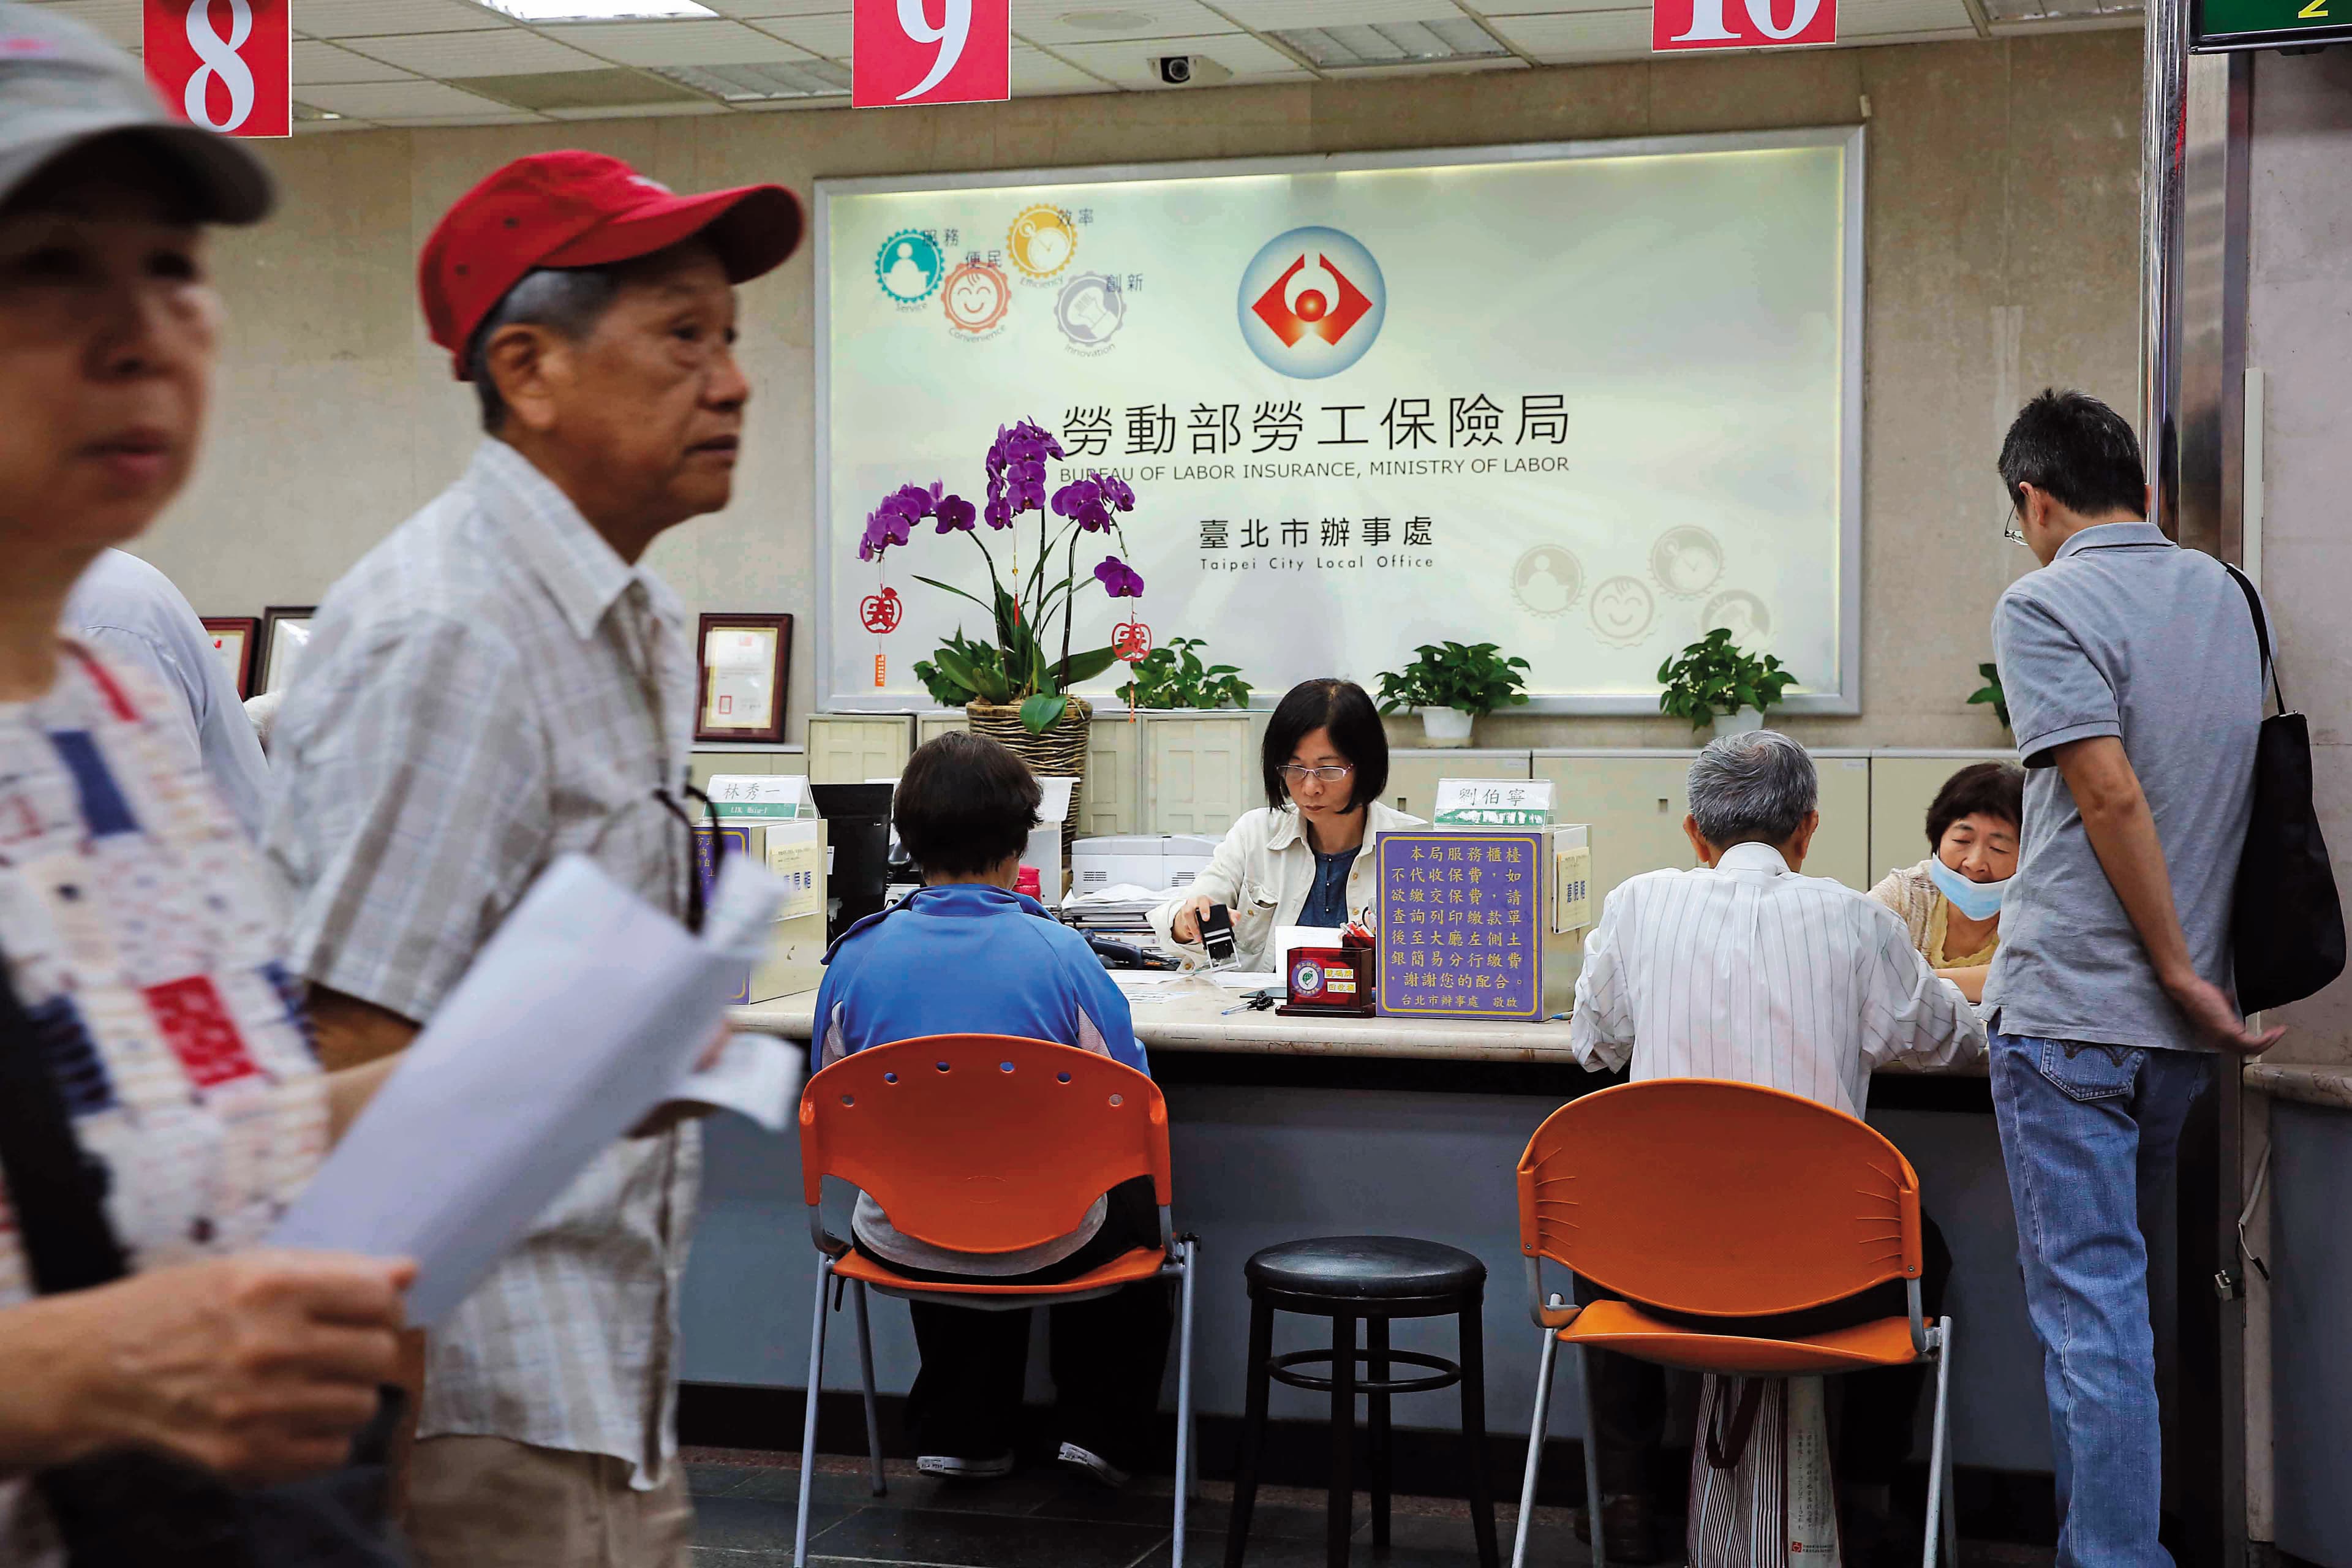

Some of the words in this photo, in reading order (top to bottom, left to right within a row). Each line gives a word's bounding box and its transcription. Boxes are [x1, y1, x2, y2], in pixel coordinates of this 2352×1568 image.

[184, 0, 255, 132] 8
[1057, 208, 1094, 227] 效率
[922, 228, 960, 246] 服務
[965, 250, 1003, 269] 便民
[1106, 273, 1144, 293] 創新
[1063, 393, 1569, 457] 勞動部勞工保險局
[1140, 466, 1166, 481] OF
[1174, 464, 1235, 480] LABOR
[1243, 461, 1361, 480] INSURANCE,
[1370, 459, 1466, 475] MINISTRY
[1471, 458, 1499, 473] OF
[1504, 456, 1570, 473] LABOR
[1200, 516, 1433, 549] 臺北市辦事處
[1200, 558, 1256, 572] Taipei
[1269, 557, 1304, 571] City
[1317, 556, 1363, 569] Local
[1376, 554, 1433, 568] Office
[724, 783, 780, 801] 林秀一
[1460, 788, 1525, 807] 劉伯寧
[1411, 845, 1523, 864] 本局服務櫃檯
[1392, 908, 1523, 927] 查詢列印繳款單
[1391, 929, 1522, 948] 後至大廳左側土
[1391, 950, 1523, 970] 銀簡易分行繳費
[1401, 994, 1480, 1008] 台北市辦事處
